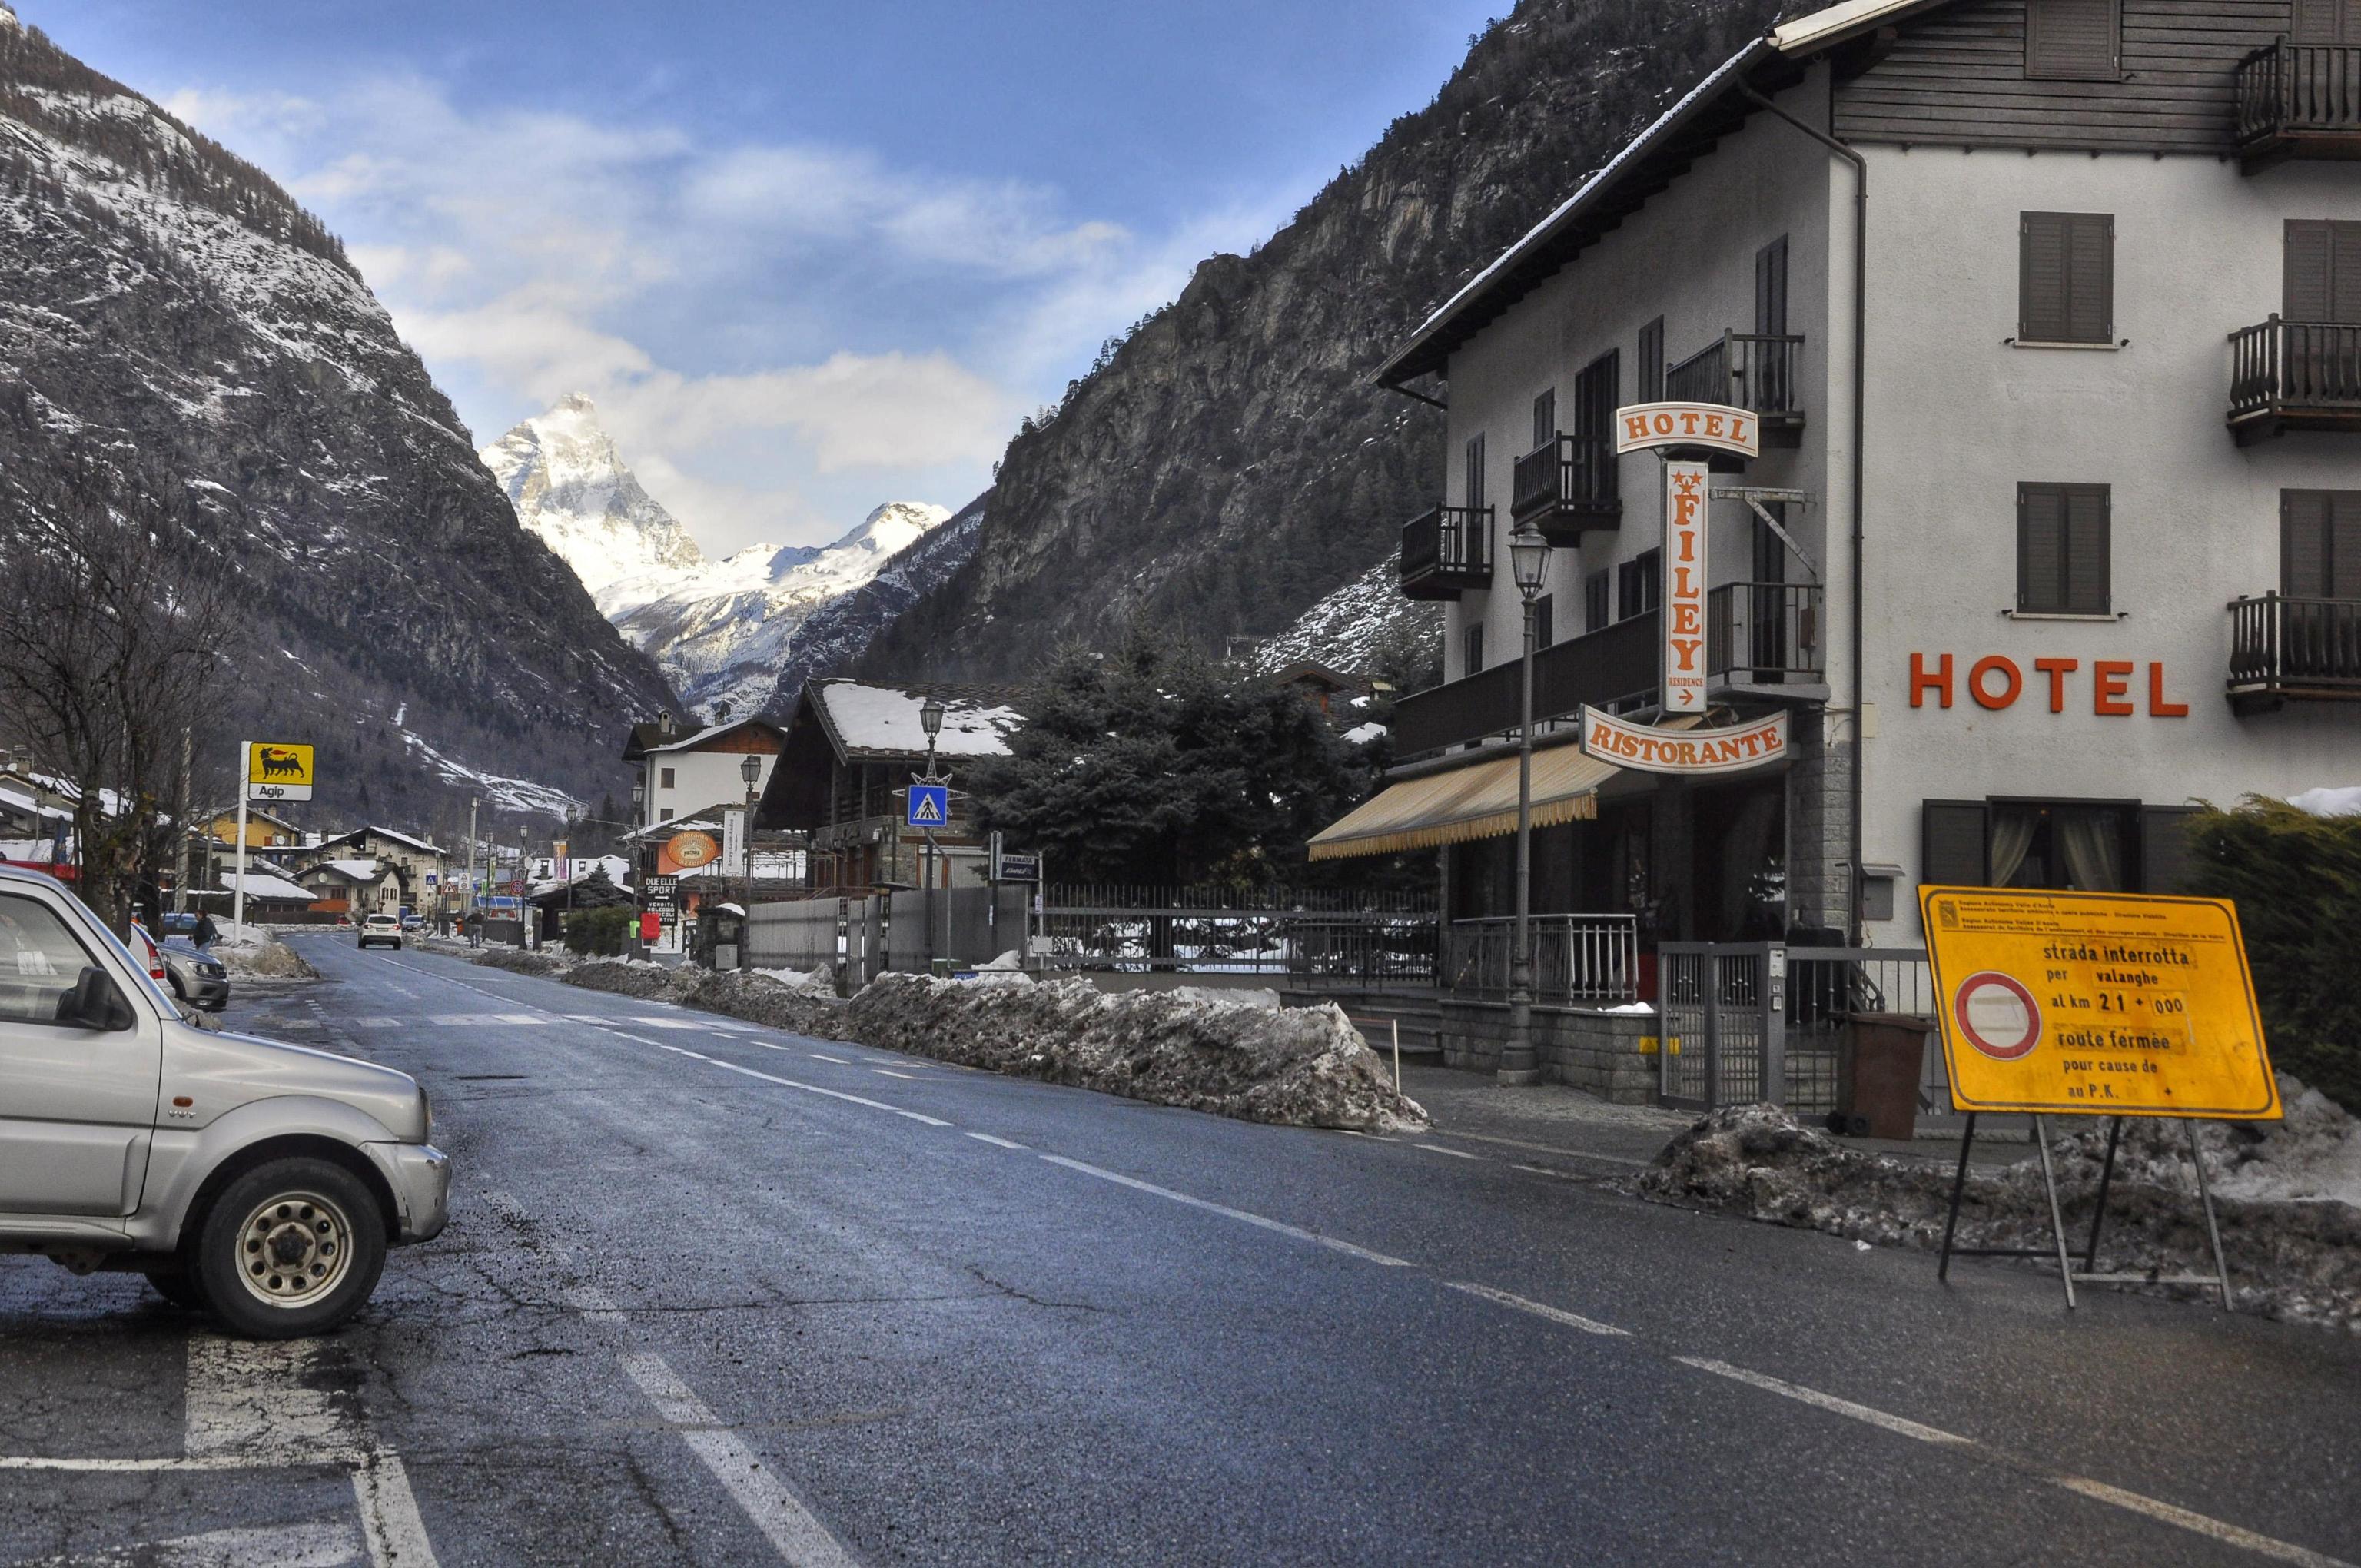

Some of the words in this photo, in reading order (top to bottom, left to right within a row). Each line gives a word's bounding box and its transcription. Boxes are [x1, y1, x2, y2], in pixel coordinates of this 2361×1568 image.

[1625, 413, 1747, 443] HOTEL
[1670, 494, 1702, 671] FILEY
[1669, 678, 1704, 686] RESIDENCE
[1910, 653, 2189, 716] HOTEL
[1589, 723, 1782, 764] RISTORANTE
[259, 786, 284, 798] Agip
[2044, 943, 2097, 961] strada
[2104, 945, 2190, 965] interrotta
[2047, 969, 2067, 982] per
[2097, 969, 2158, 986] valanghe
[2052, 994, 2065, 1008] al
[2070, 994, 2090, 1008] km
[2155, 998, 2183, 1014] 000
[2057, 1029, 2104, 1047] route
[2110, 1030, 2170, 1049] fermée
[2063, 1059, 2093, 1074] pour
[2099, 1061, 2137, 1073] cause
[2143, 1059, 2157, 1073] de
[2068, 1086, 2084, 1098] au
[2089, 1084, 2119, 1099] P.K.
